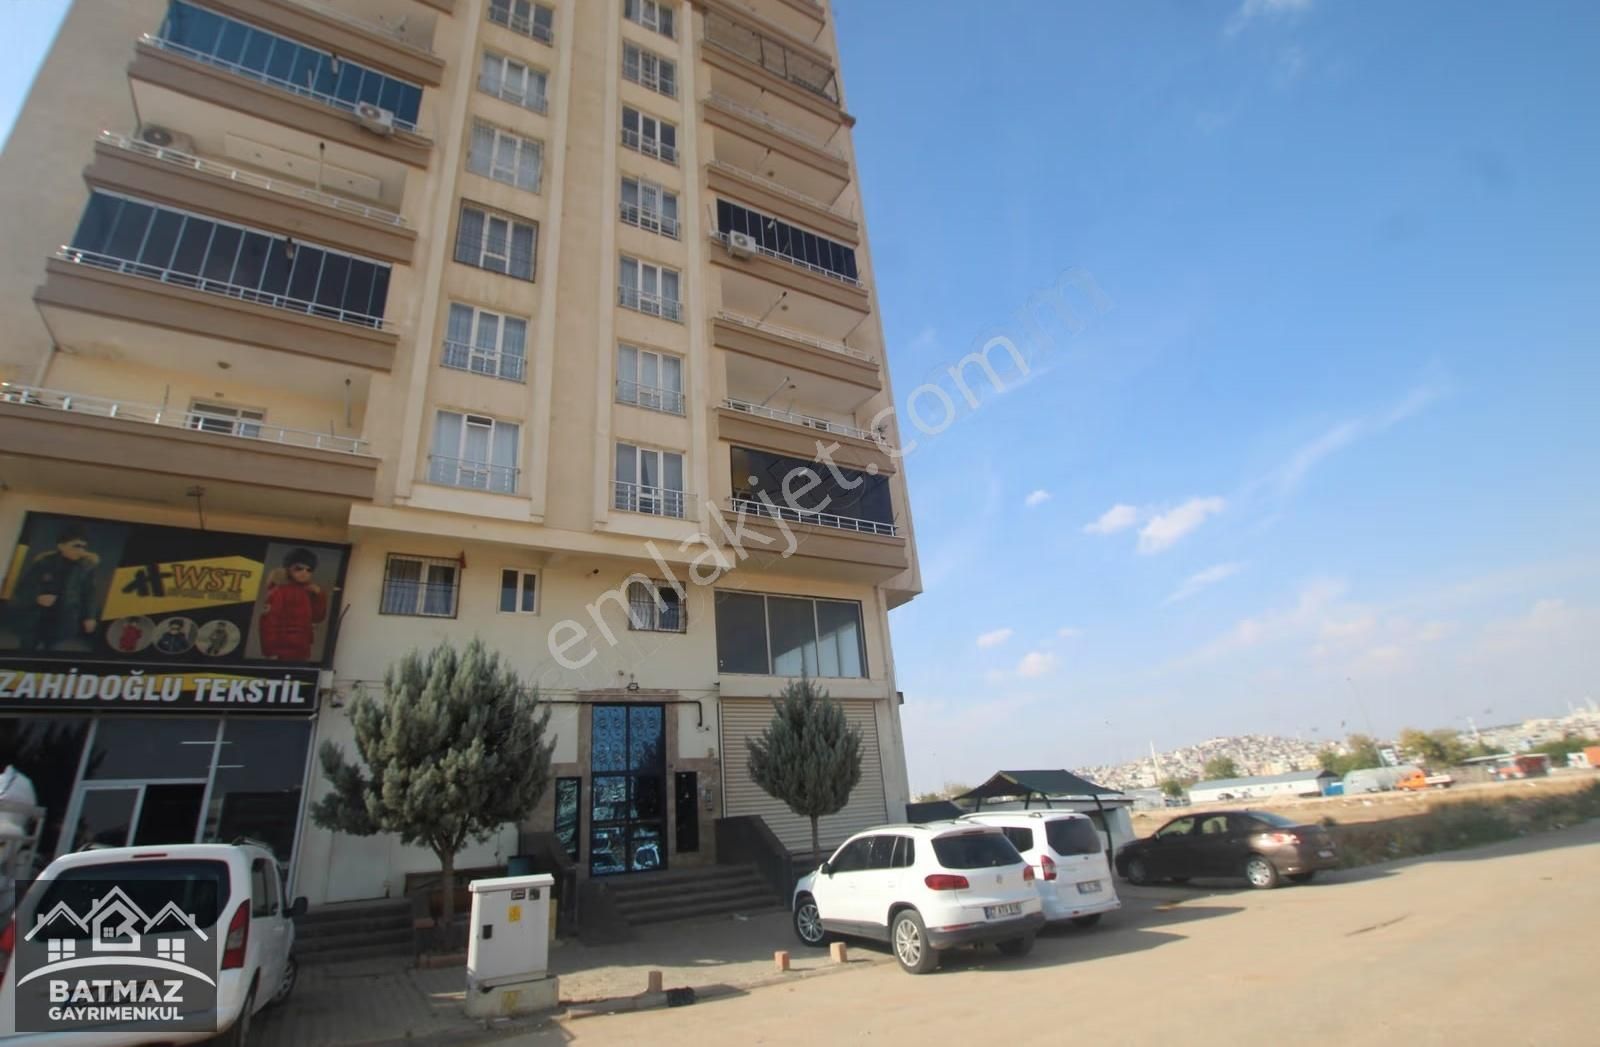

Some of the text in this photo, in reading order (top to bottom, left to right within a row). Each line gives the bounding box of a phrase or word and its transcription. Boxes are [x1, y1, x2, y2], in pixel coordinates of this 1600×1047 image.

[171, 563, 252, 593] WST
[0, 667, 305, 703] ZAHİDOĞLU TEKSTİL
